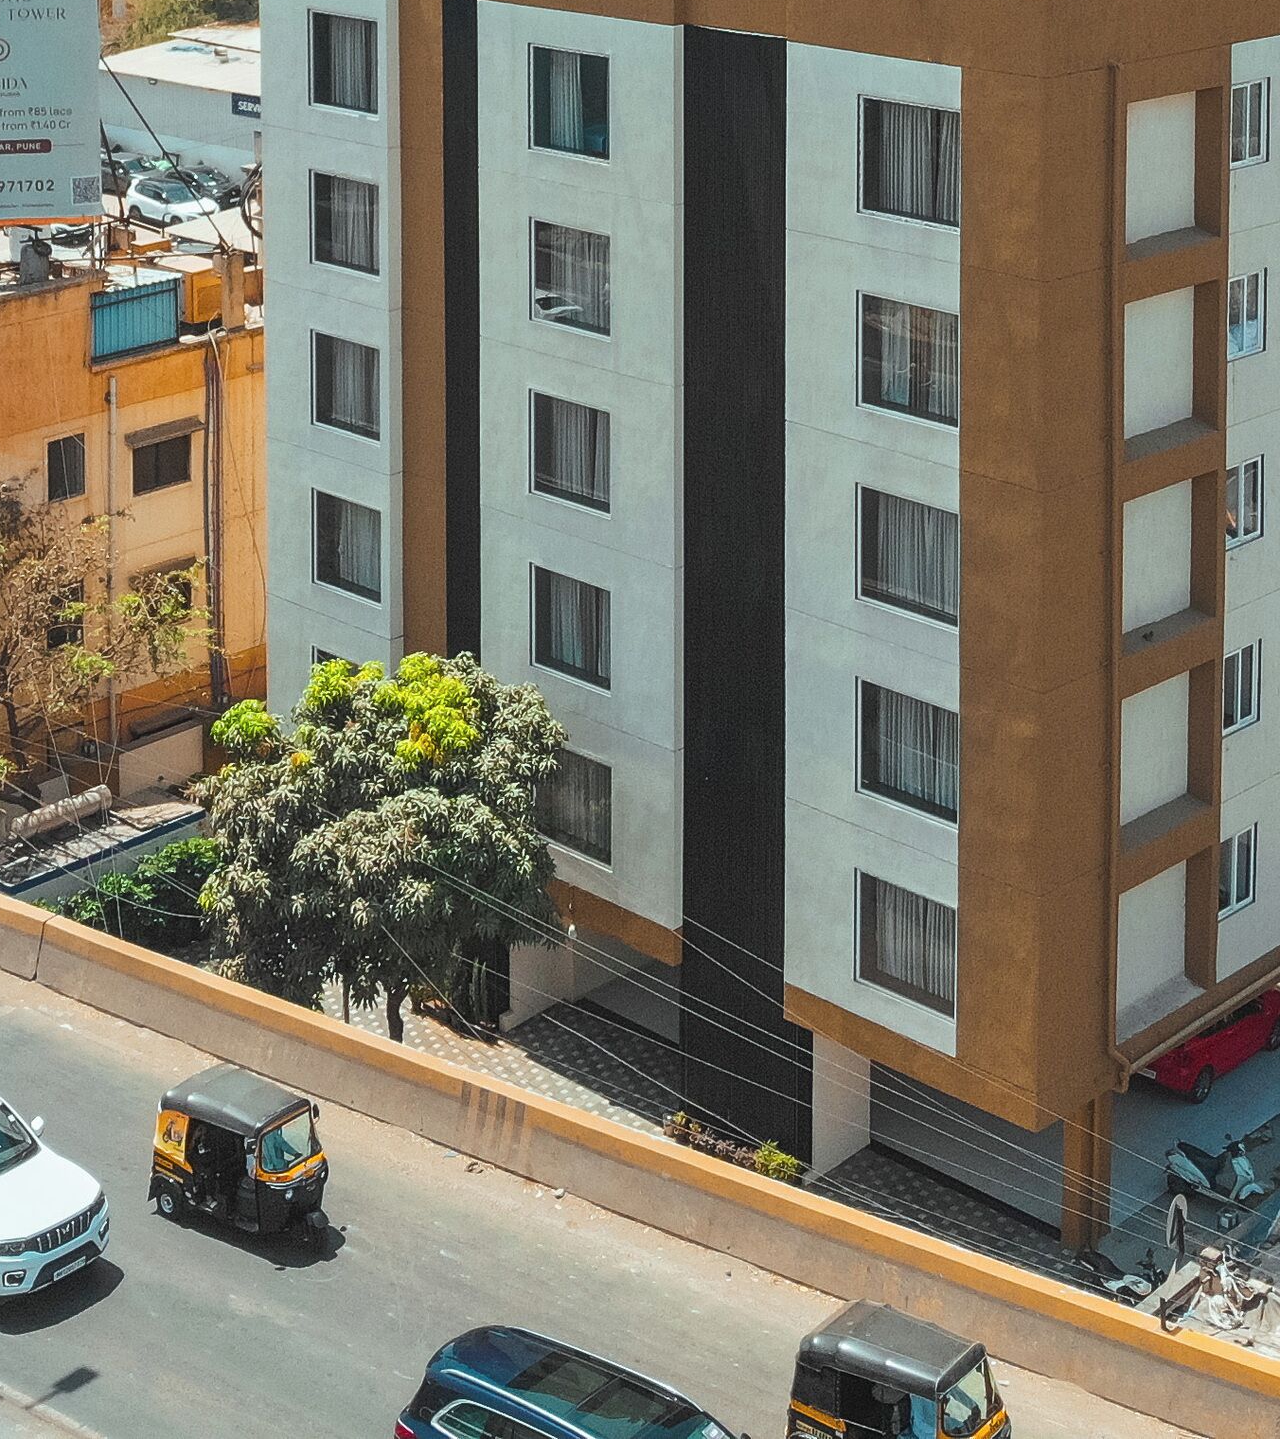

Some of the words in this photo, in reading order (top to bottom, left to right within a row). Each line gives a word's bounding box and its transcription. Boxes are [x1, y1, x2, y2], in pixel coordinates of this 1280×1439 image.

[8, 7, 66, 21] TOWER
[0, 108, 26, 118] from
[2, 121, 28, 131] from
[58, 119, 71, 129] Cr
[16, 142, 42, 151] PUNE
